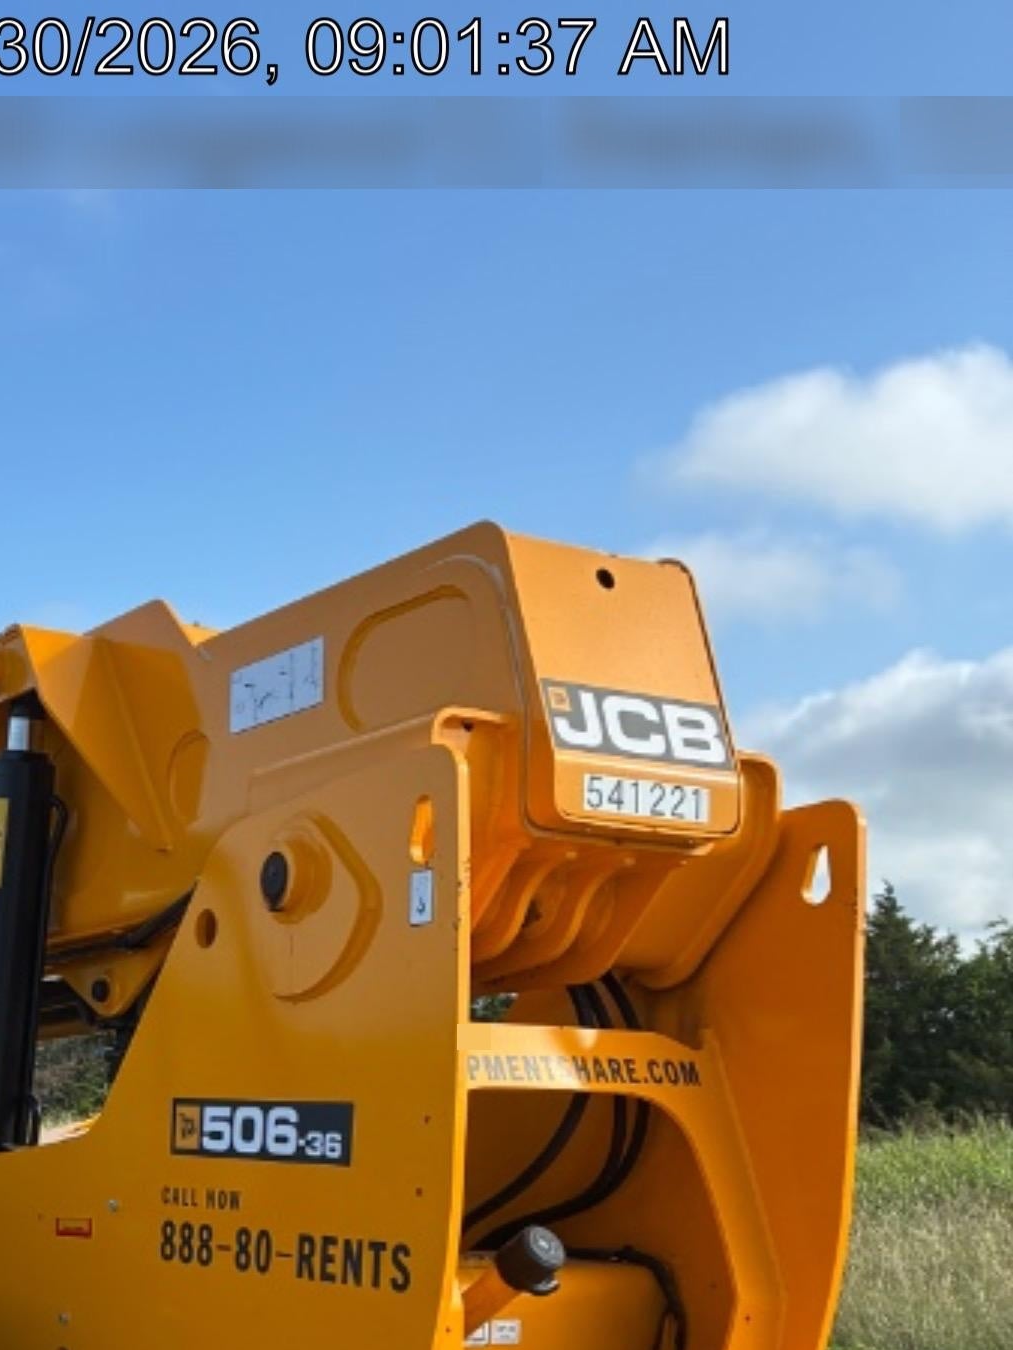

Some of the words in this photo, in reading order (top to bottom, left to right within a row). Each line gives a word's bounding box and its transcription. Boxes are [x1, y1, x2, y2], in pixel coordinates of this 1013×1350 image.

[554, 689, 726, 763] JCB
[587, 775, 700, 819] 541221
[202, 1106, 342, 1158] 506-36
[161, 1186, 198, 1207] CALL
[205, 1188, 241, 1210] NOW
[160, 1220, 412, 1293] 888-80-RENTS
